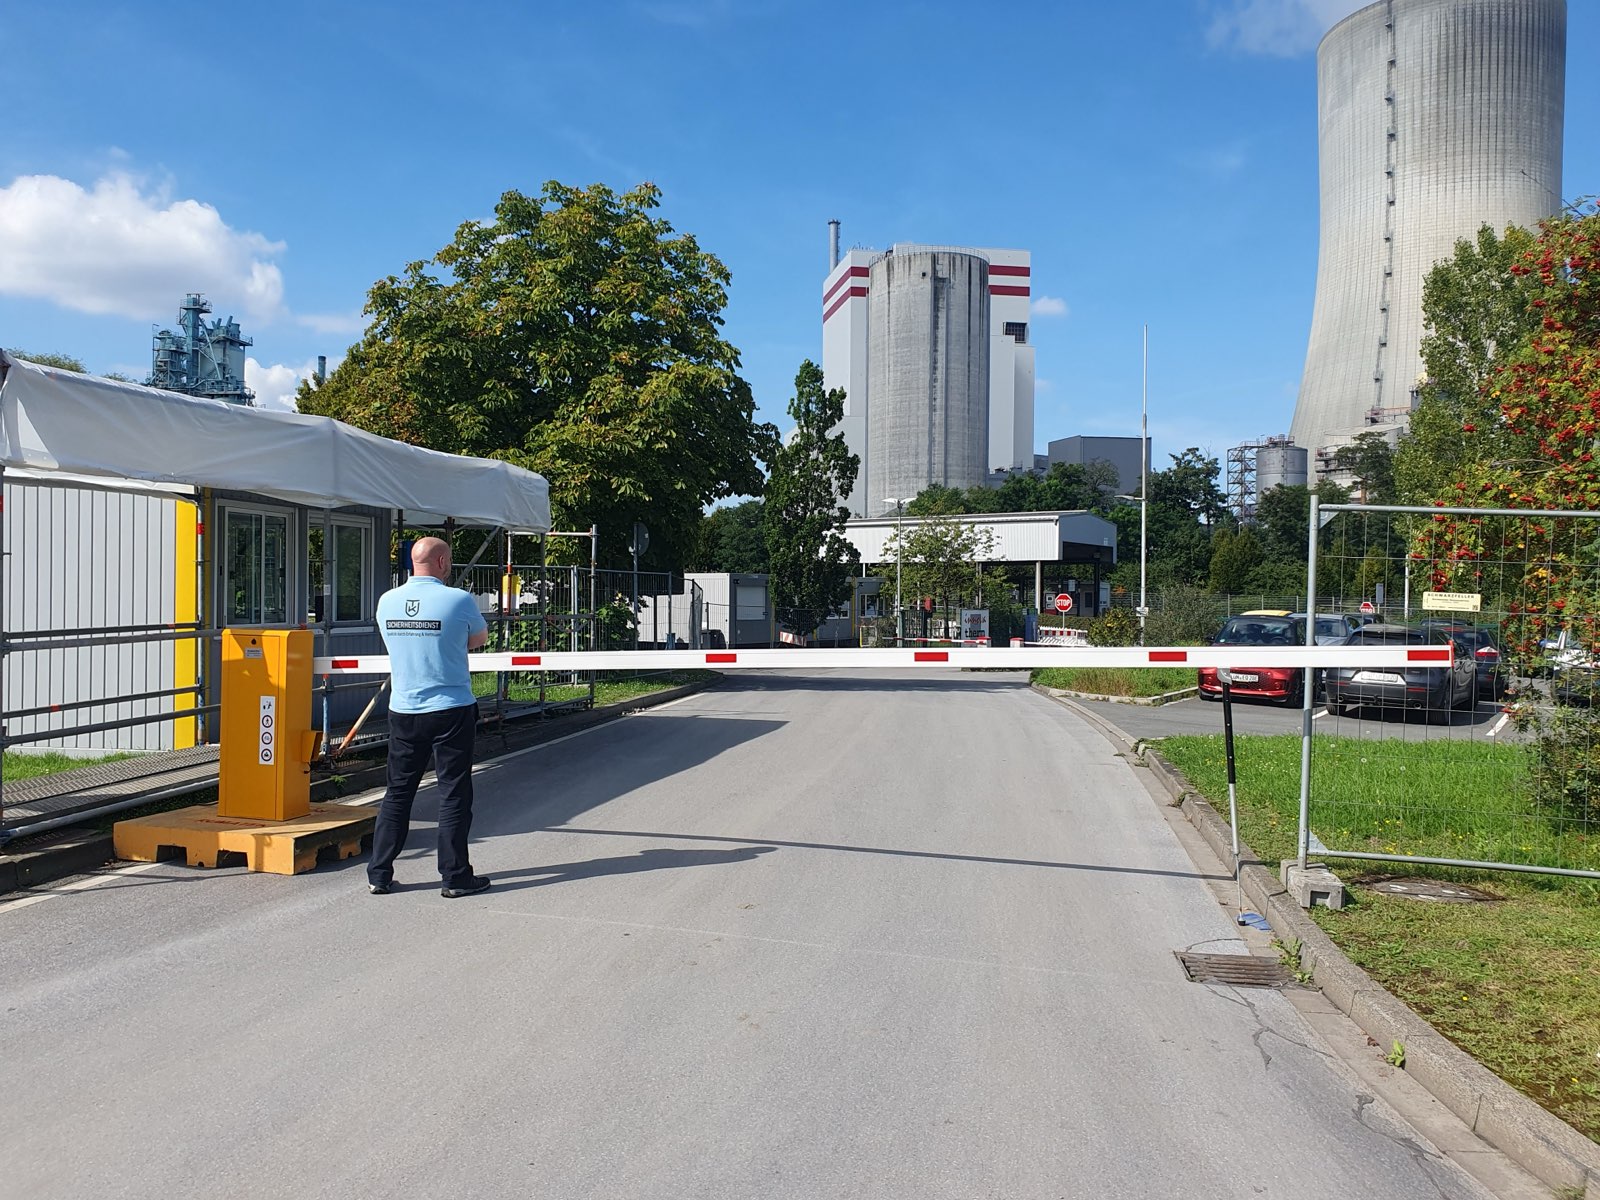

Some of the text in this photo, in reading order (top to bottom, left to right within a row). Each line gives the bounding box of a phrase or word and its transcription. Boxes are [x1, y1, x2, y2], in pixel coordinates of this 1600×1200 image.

[1056, 599, 1071, 607] STOP
[387, 621, 440, 629] SICHERHEITSDIENST
[964, 628, 986, 638] therm
